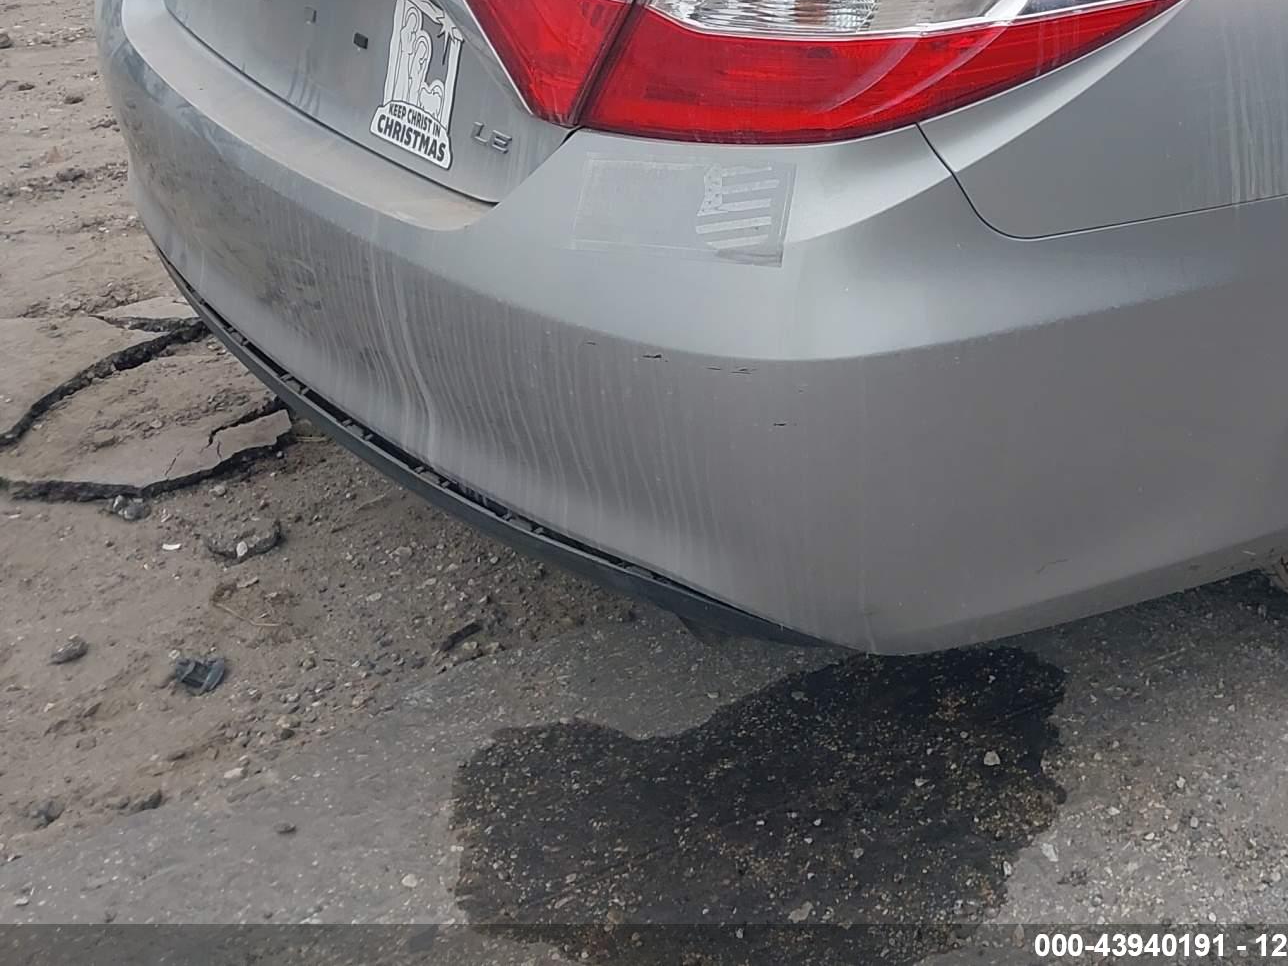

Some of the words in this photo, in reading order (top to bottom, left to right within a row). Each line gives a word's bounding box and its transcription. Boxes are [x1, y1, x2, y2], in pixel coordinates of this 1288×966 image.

[377, 114, 446, 162] CHRISTMAS
[388, 103, 407, 120] KEEP
[407, 108, 432, 132] CHRIST
[432, 122, 441, 138] IN
[471, 121, 513, 154] LE
